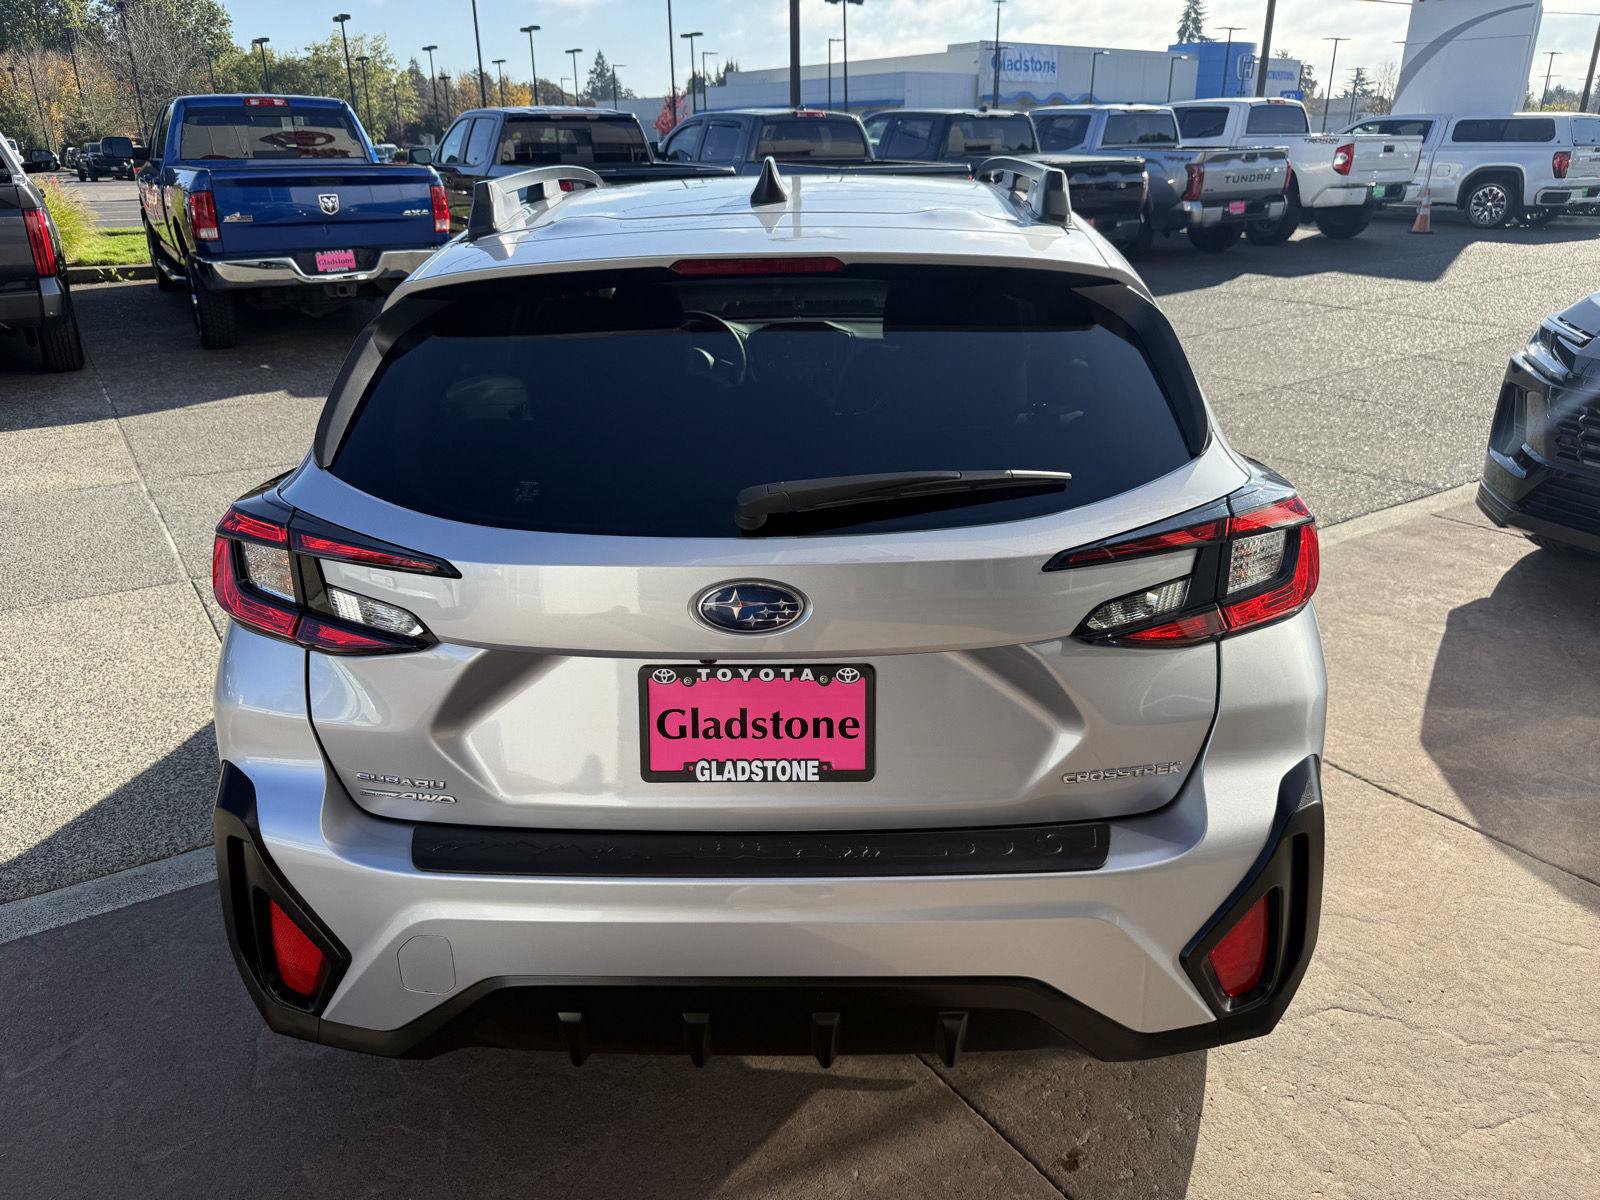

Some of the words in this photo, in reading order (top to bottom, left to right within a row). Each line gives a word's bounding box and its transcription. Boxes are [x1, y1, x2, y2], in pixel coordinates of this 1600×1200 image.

[1224, 174, 1271, 184] TUNDRA
[697, 668, 815, 682] TOYOTA
[656, 707, 860, 739] Gladstone
[695, 760, 820, 782] GLADSTONE
[1062, 760, 1183, 784] CROSSTREK
[356, 772, 446, 790] SUBARU
[399, 792, 457, 804] AWD
